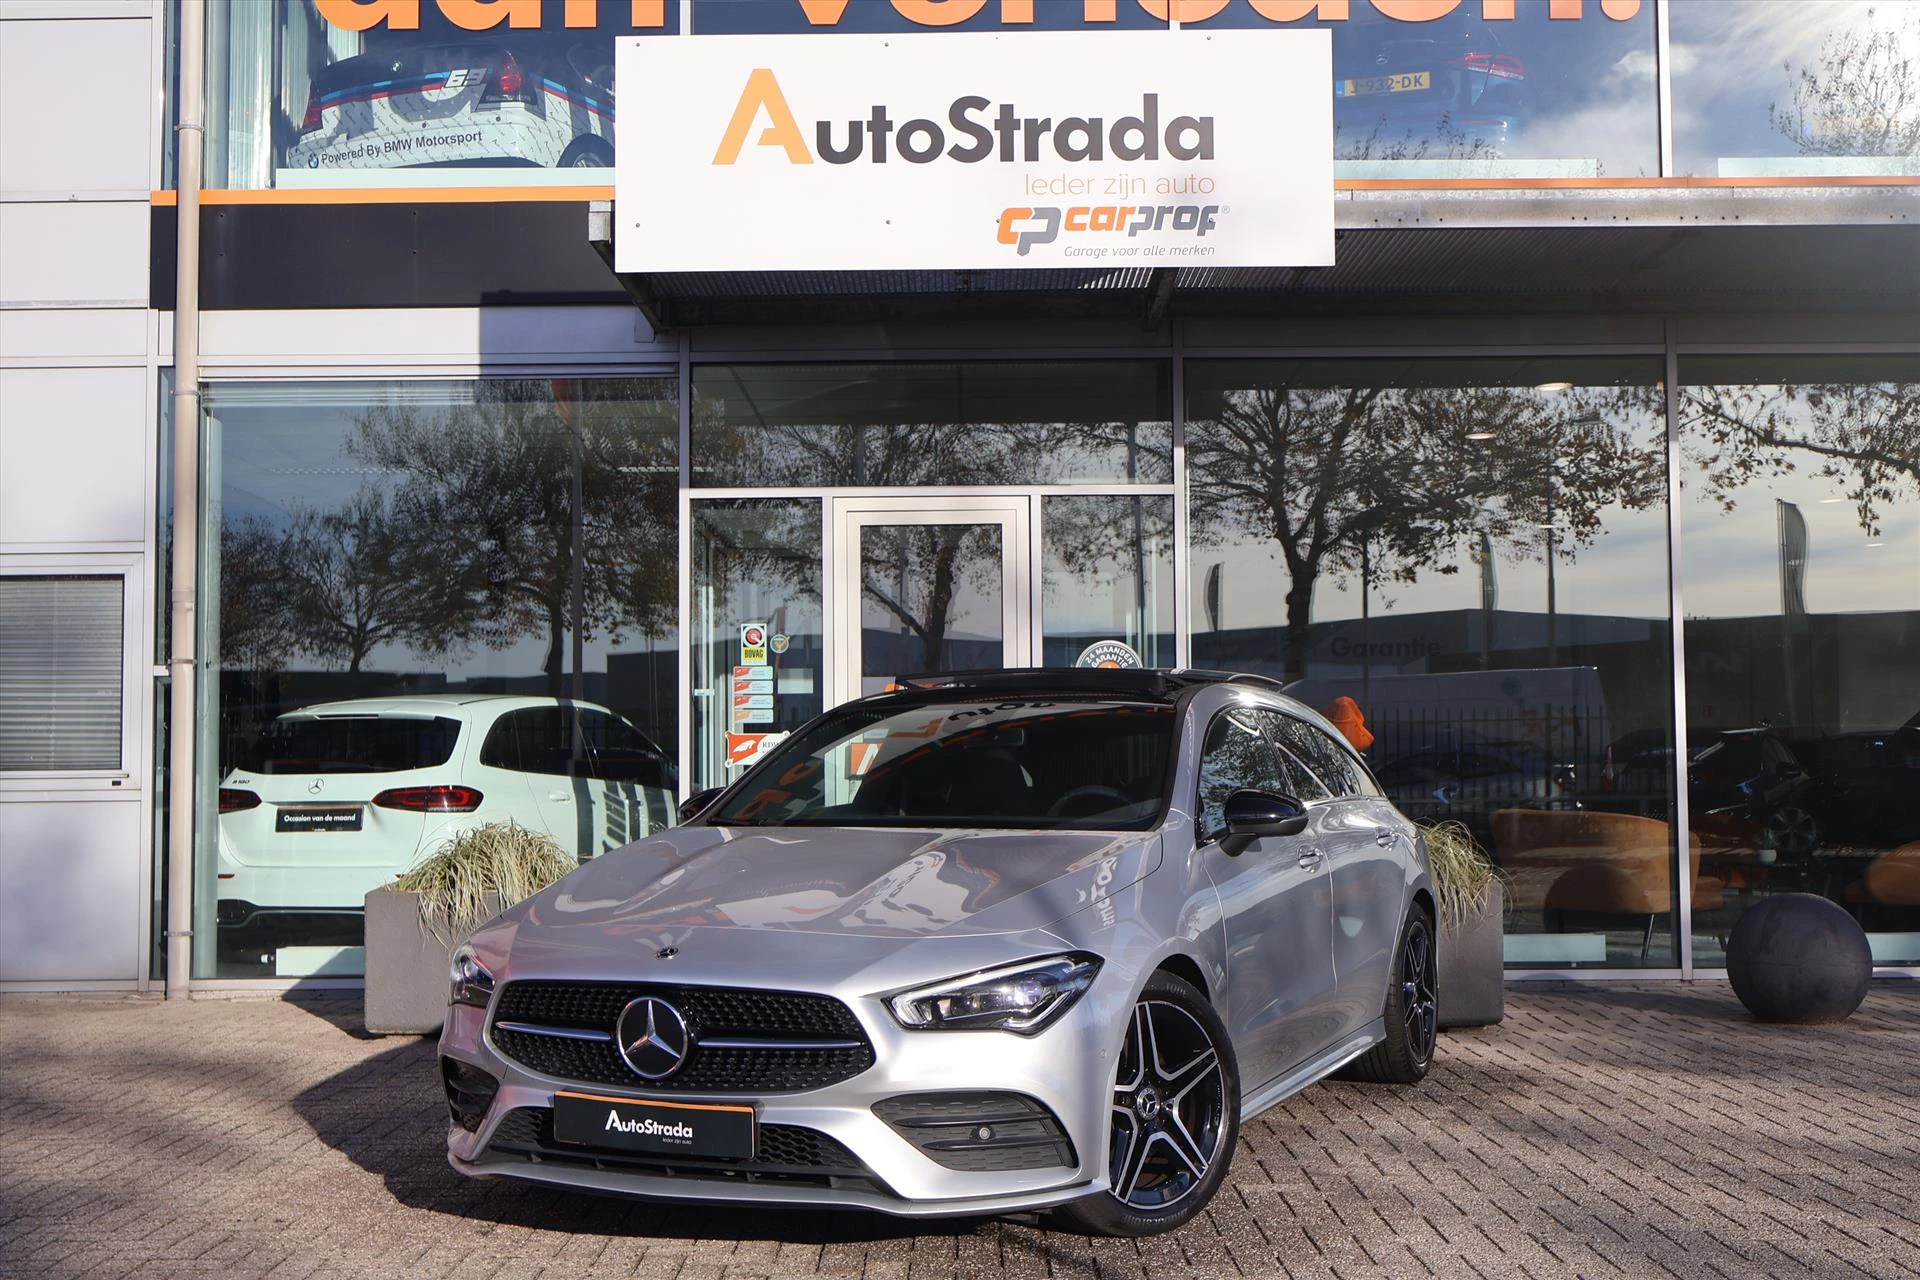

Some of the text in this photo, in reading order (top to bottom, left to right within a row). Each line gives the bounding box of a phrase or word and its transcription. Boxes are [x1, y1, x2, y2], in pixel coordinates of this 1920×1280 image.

[445, 68, 488, 88] 69
[711, 68, 1215, 165] AutoStrada
[322, 131, 483, 165] Powered By BMW Motorsport
[1026, 173, 1215, 200] Ieder zijn auto
[1064, 205, 1219, 236] carprof
[1064, 244, 1215, 259] Garage voor alle merken
[744, 649, 764, 658] BOVAG
[1085, 646, 1135, 664] 24 MAANDEN
[1330, 636, 1441, 657] Garantie
[1091, 654, 1129, 668] GARANTIE
[284, 814, 311, 822] Occasion
[324, 814, 332, 822] de
[333, 813, 356, 822] maand
[605, 1109, 693, 1138] AutoStrada
